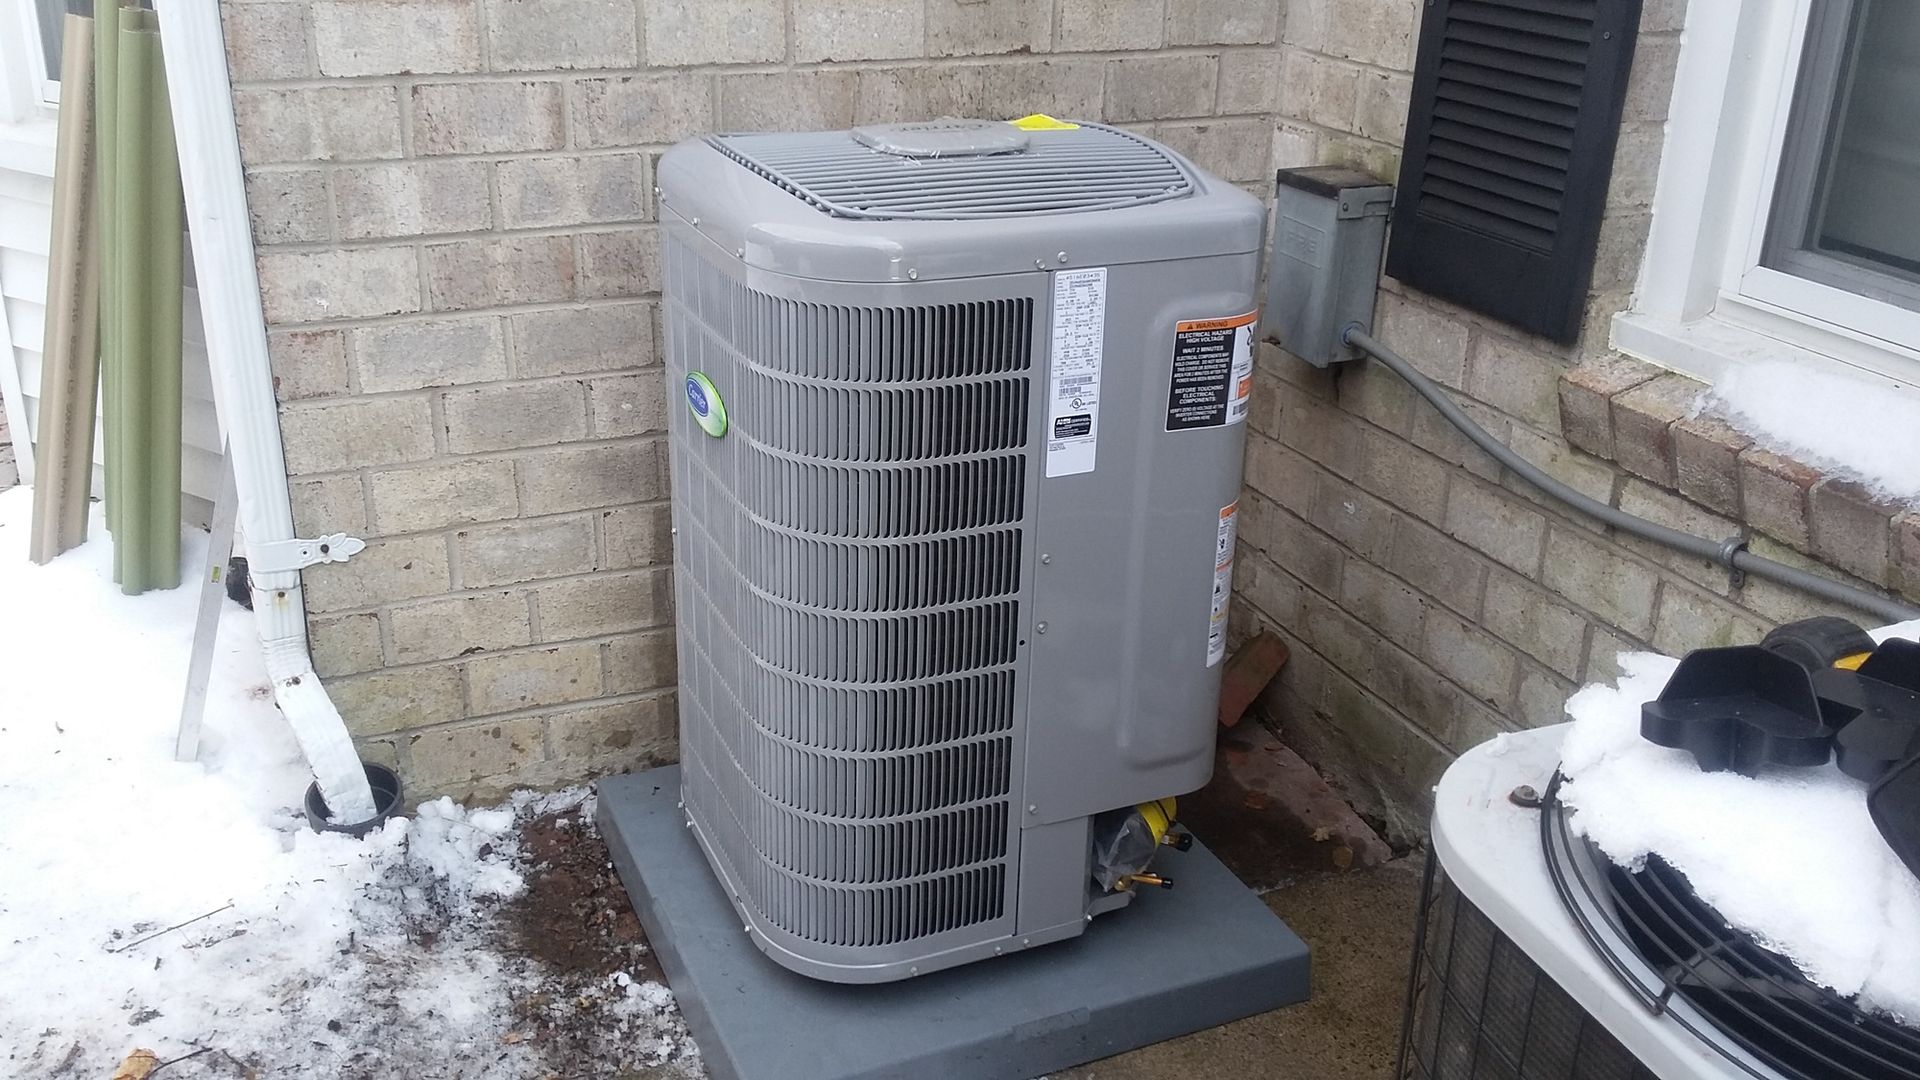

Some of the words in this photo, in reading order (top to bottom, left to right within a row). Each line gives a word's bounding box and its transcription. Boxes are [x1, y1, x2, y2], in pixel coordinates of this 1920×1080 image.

[1196, 320, 1228, 329] WARNING
[1178, 331, 1210, 339] ELECTRICAL
[1175, 386, 1196, 394] BEFORE
[1197, 384, 1224, 392] TOUCHING
[688, 383, 707, 409] Carrier
